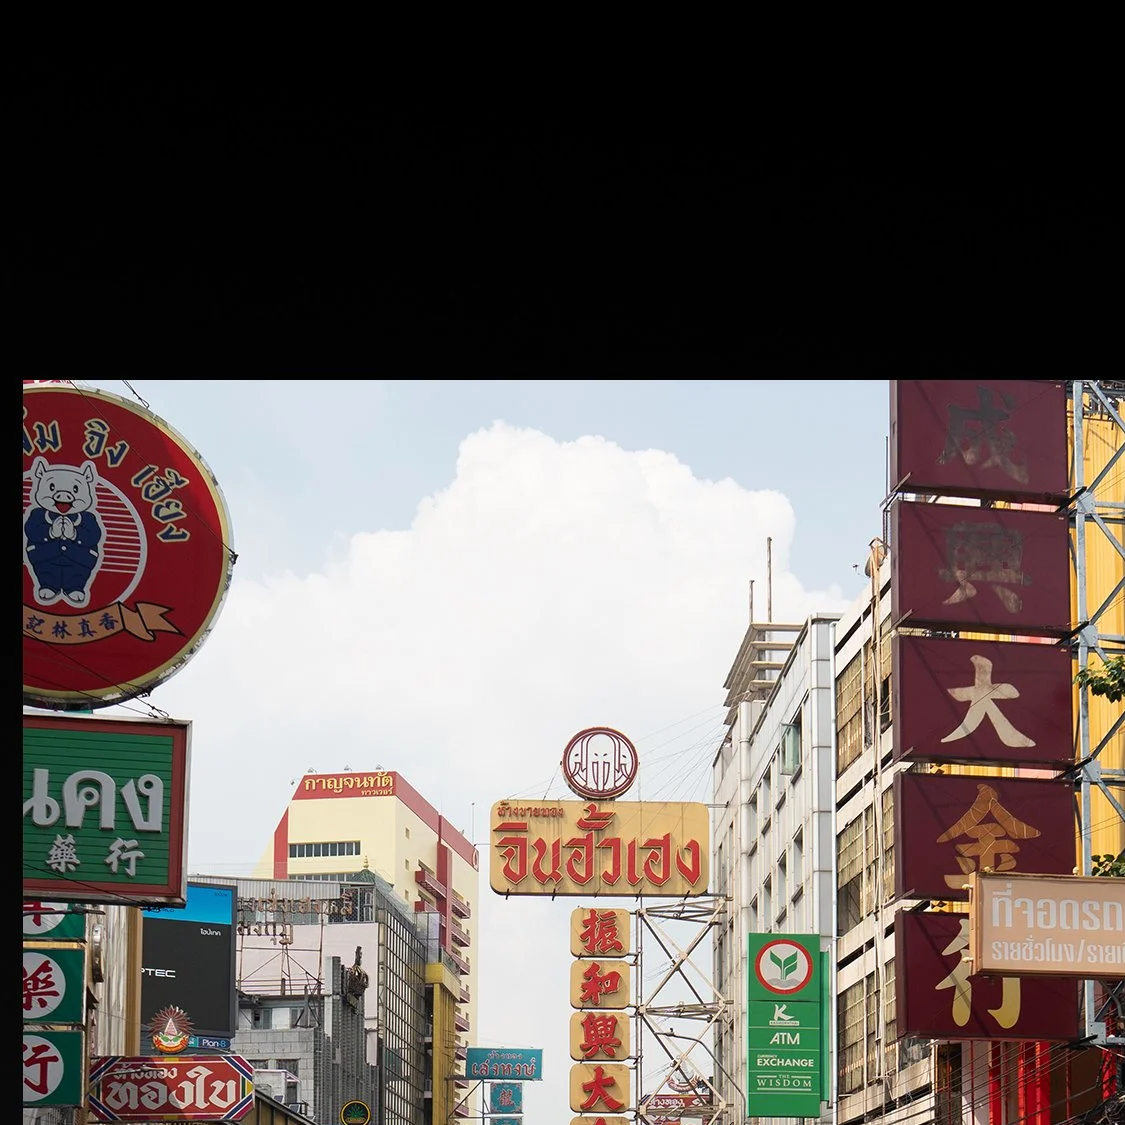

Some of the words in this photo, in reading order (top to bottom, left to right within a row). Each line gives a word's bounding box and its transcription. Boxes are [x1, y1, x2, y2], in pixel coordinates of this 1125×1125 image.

[493, 803, 702, 887] จินฮั้วเฮง
[991, 882, 1123, 931] ที่จอดรถ
[991, 934, 1125, 963] รายชั่วโมง/รายเ
[769, 1033, 800, 1045] ATM
[757, 1058, 814, 1067] EXCHANGE
[757, 1079, 812, 1087] WISDOM
